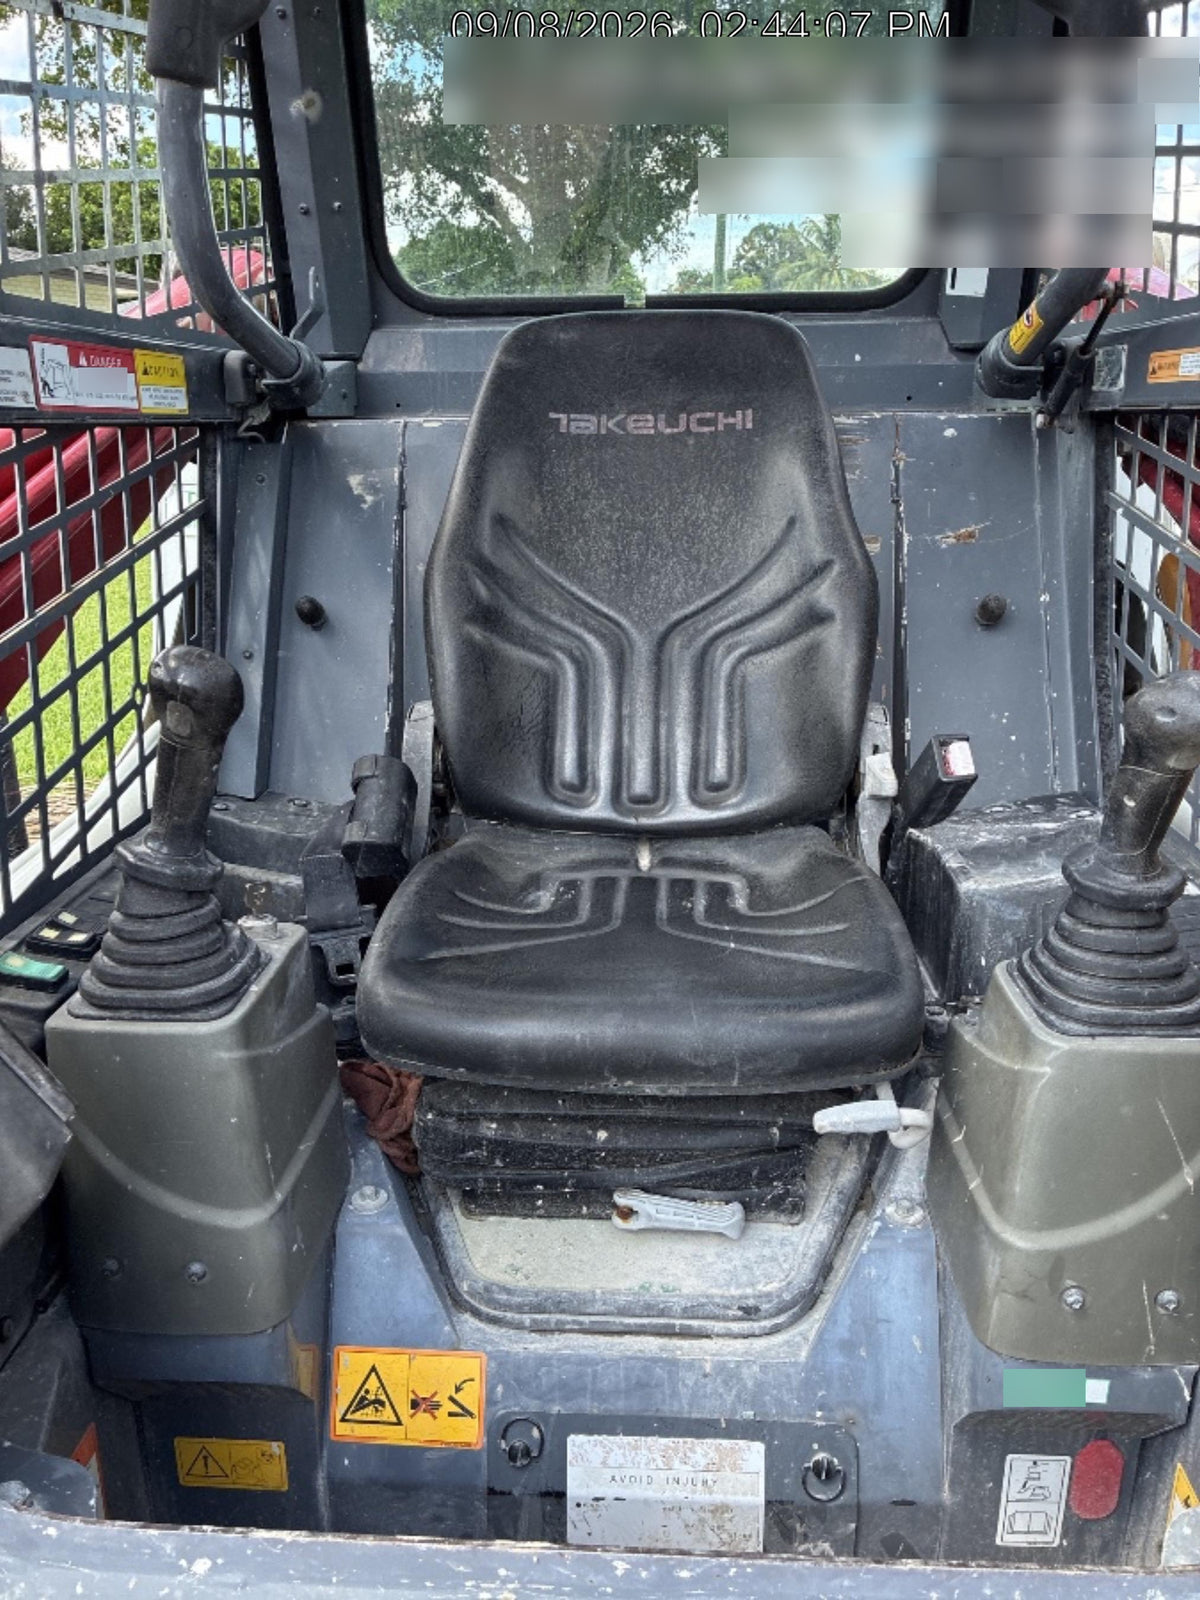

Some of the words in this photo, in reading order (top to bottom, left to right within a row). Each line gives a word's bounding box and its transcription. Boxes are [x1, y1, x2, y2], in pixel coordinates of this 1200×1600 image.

[548, 408, 753, 435] TAKEUCHI
[608, 1474, 654, 1486] AVOID
[665, 1474, 719, 1487] INJURY
